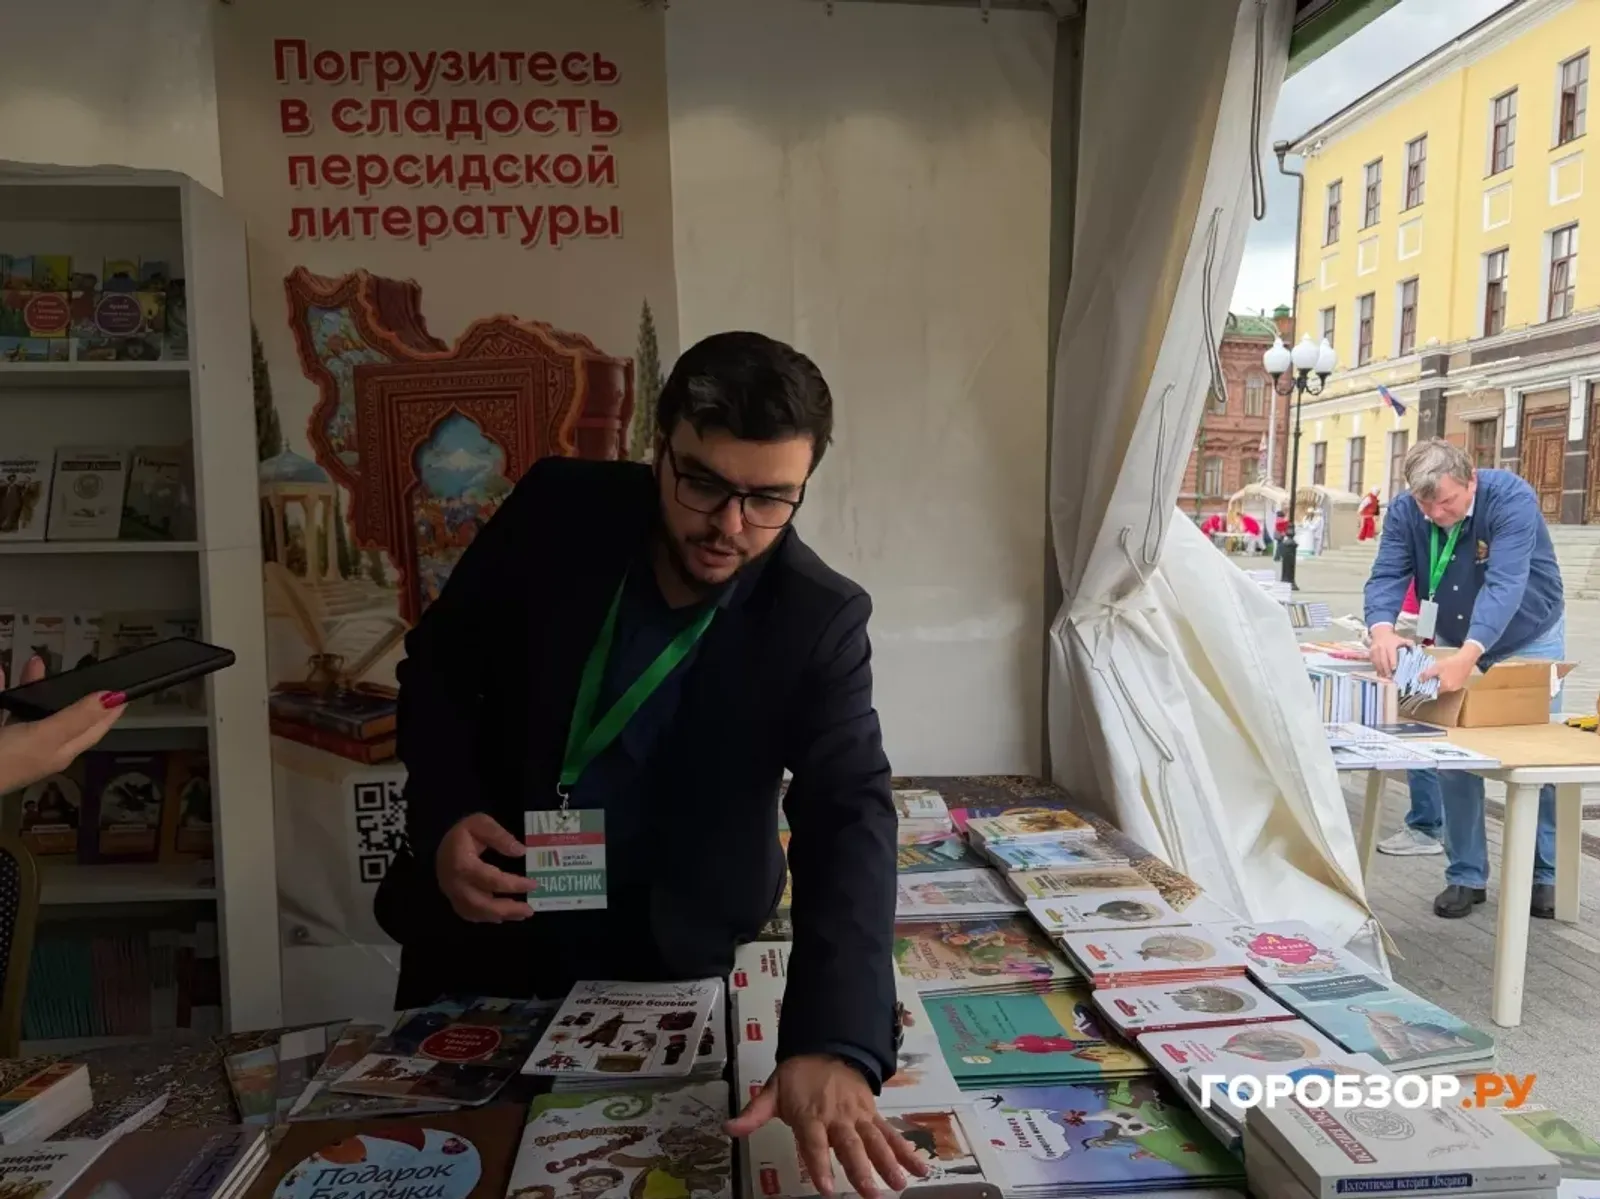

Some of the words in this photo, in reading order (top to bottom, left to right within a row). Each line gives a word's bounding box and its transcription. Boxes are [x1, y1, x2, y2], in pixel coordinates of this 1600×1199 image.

[274, 38, 620, 92] Погрузитесь
[280, 98, 312, 134] в
[331, 98, 620, 141] сладость
[288, 145, 616, 197] персидской
[288, 204, 620, 247] литературы
[312, 1163, 456, 1188] Подарок
